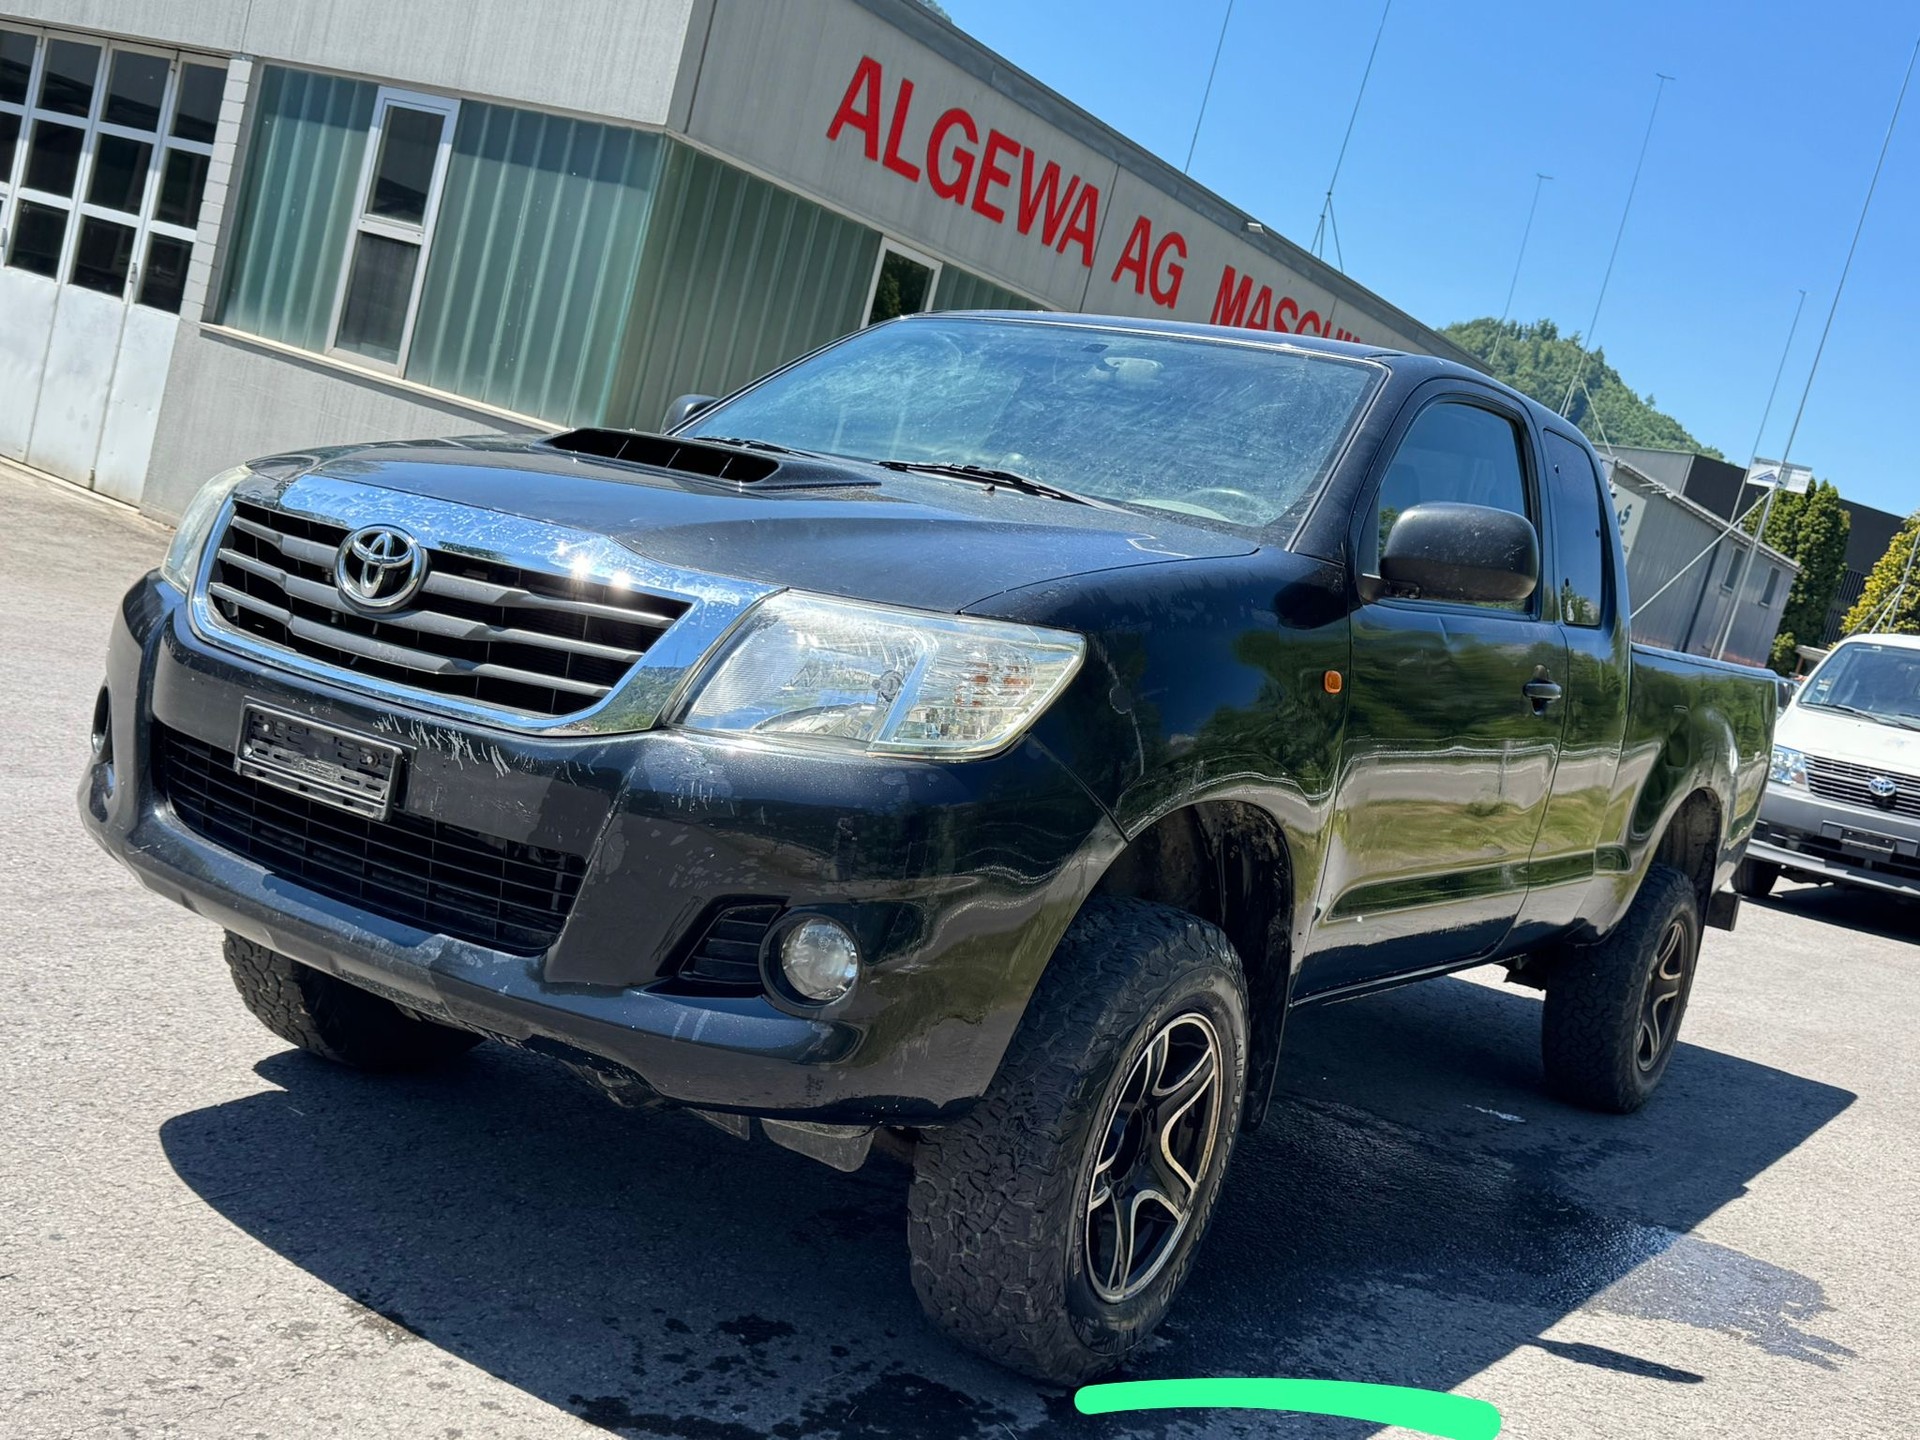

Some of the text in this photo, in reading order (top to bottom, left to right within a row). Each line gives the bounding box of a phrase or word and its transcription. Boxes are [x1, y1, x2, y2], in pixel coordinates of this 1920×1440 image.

[826, 55, 1361, 343] ALGEWA AG MASC
